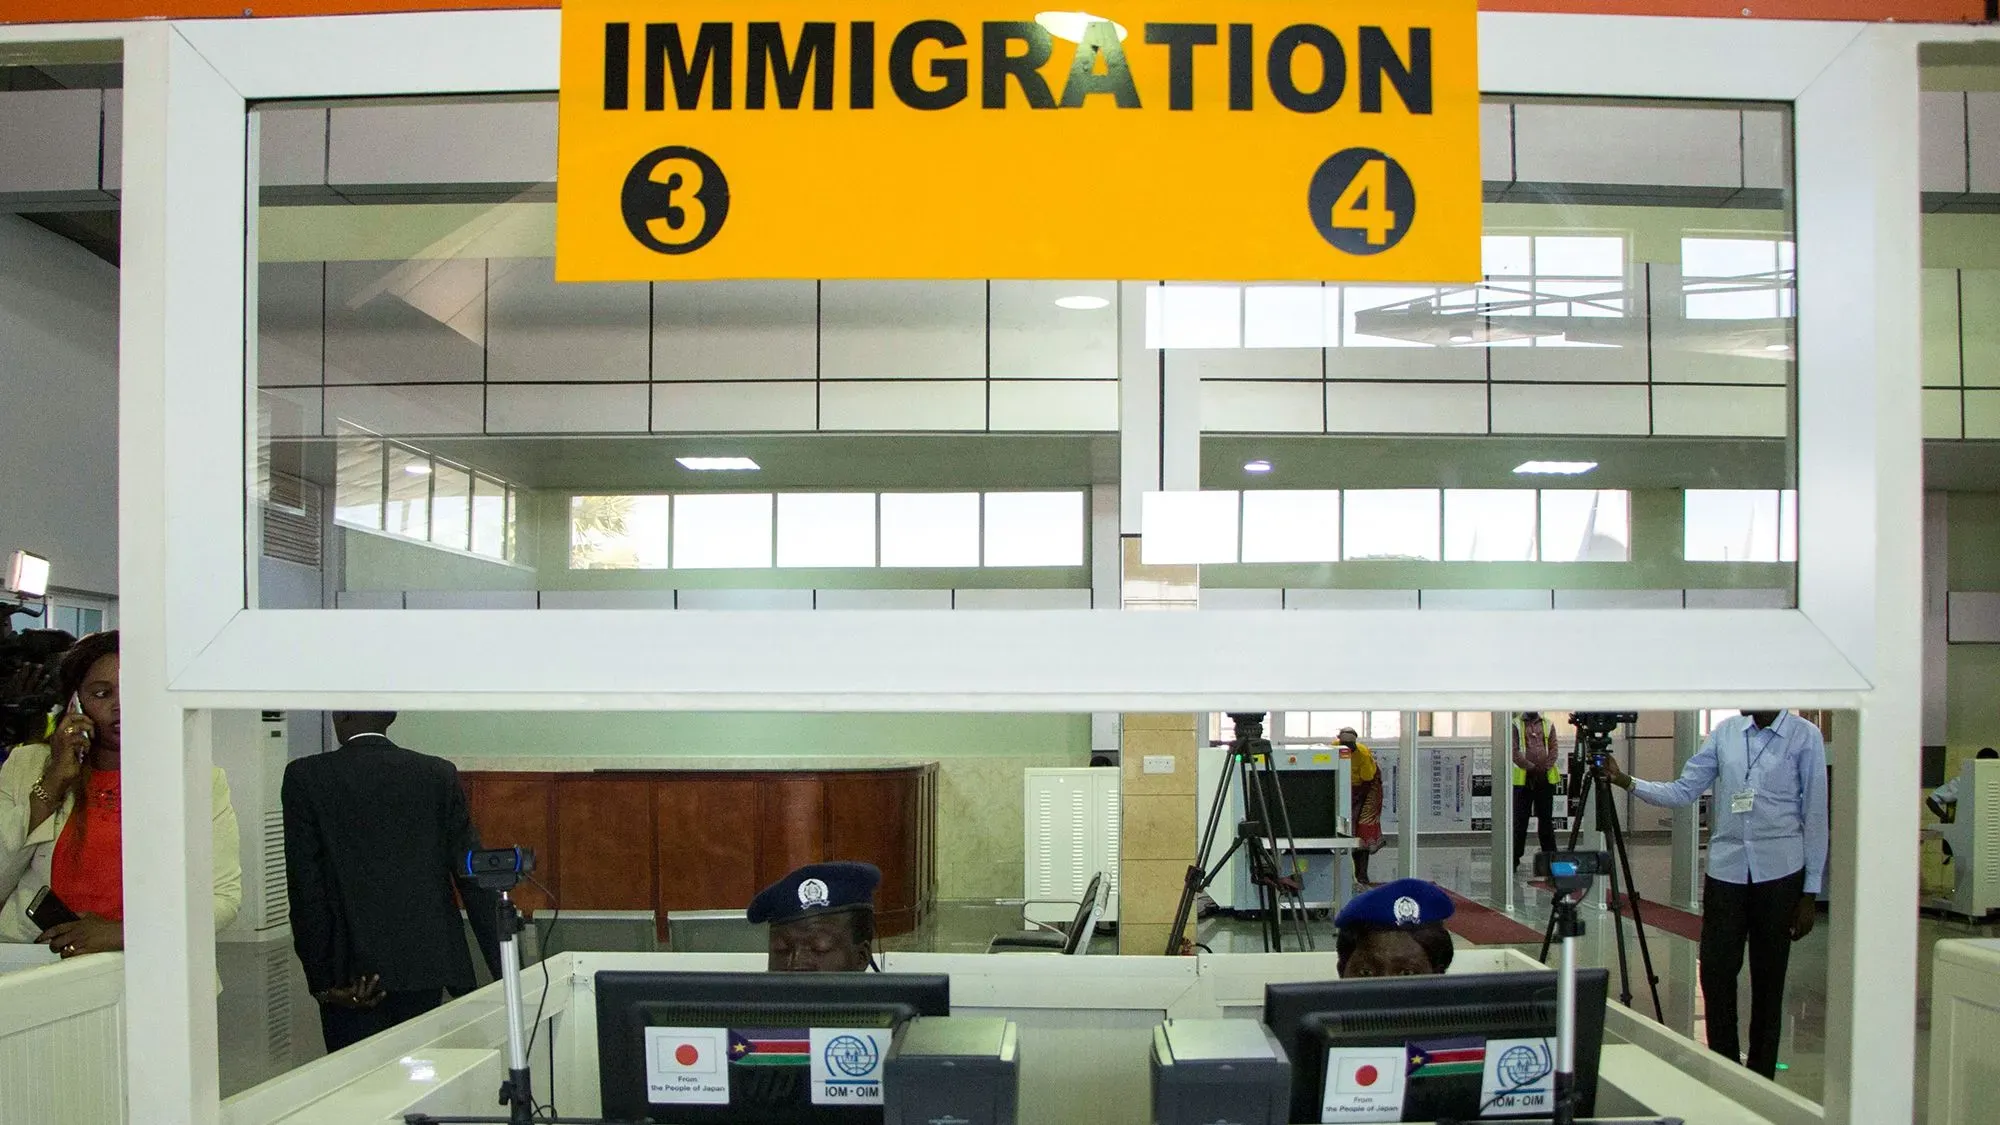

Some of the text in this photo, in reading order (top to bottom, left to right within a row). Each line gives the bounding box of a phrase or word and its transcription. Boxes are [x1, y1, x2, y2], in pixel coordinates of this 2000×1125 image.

[603, 21, 1434, 116] IMMIGRATION
[645, 156, 707, 247] 3
[1330, 158, 1396, 246] 4
